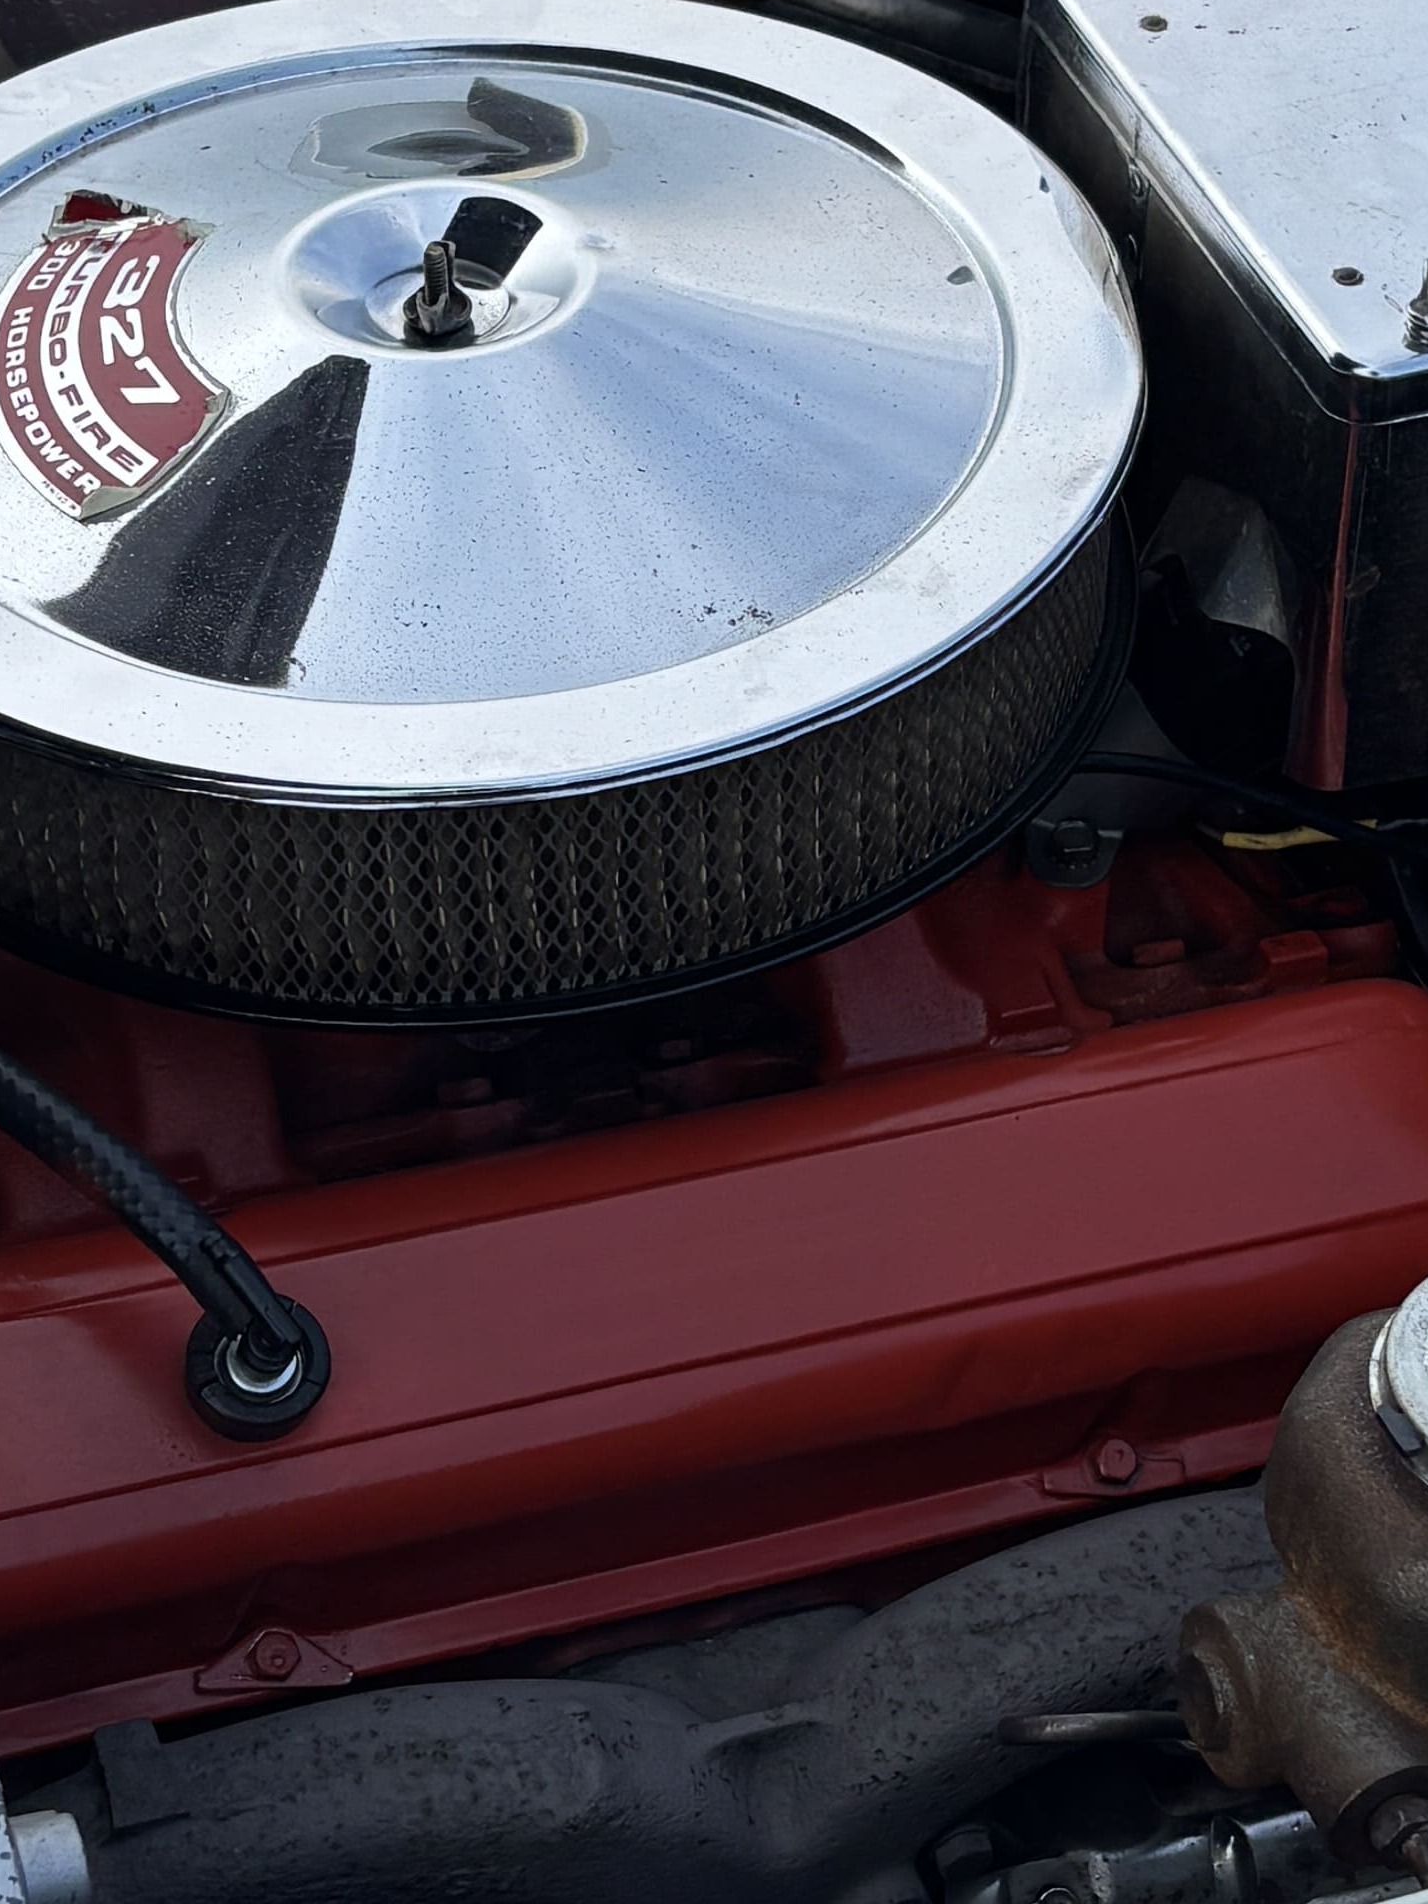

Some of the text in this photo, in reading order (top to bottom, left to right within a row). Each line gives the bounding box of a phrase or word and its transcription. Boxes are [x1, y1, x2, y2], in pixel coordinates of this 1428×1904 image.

[27, 239, 81, 291] 300
[99, 254, 181, 405] 327
[5, 306, 102, 495] HORSEPOWER
